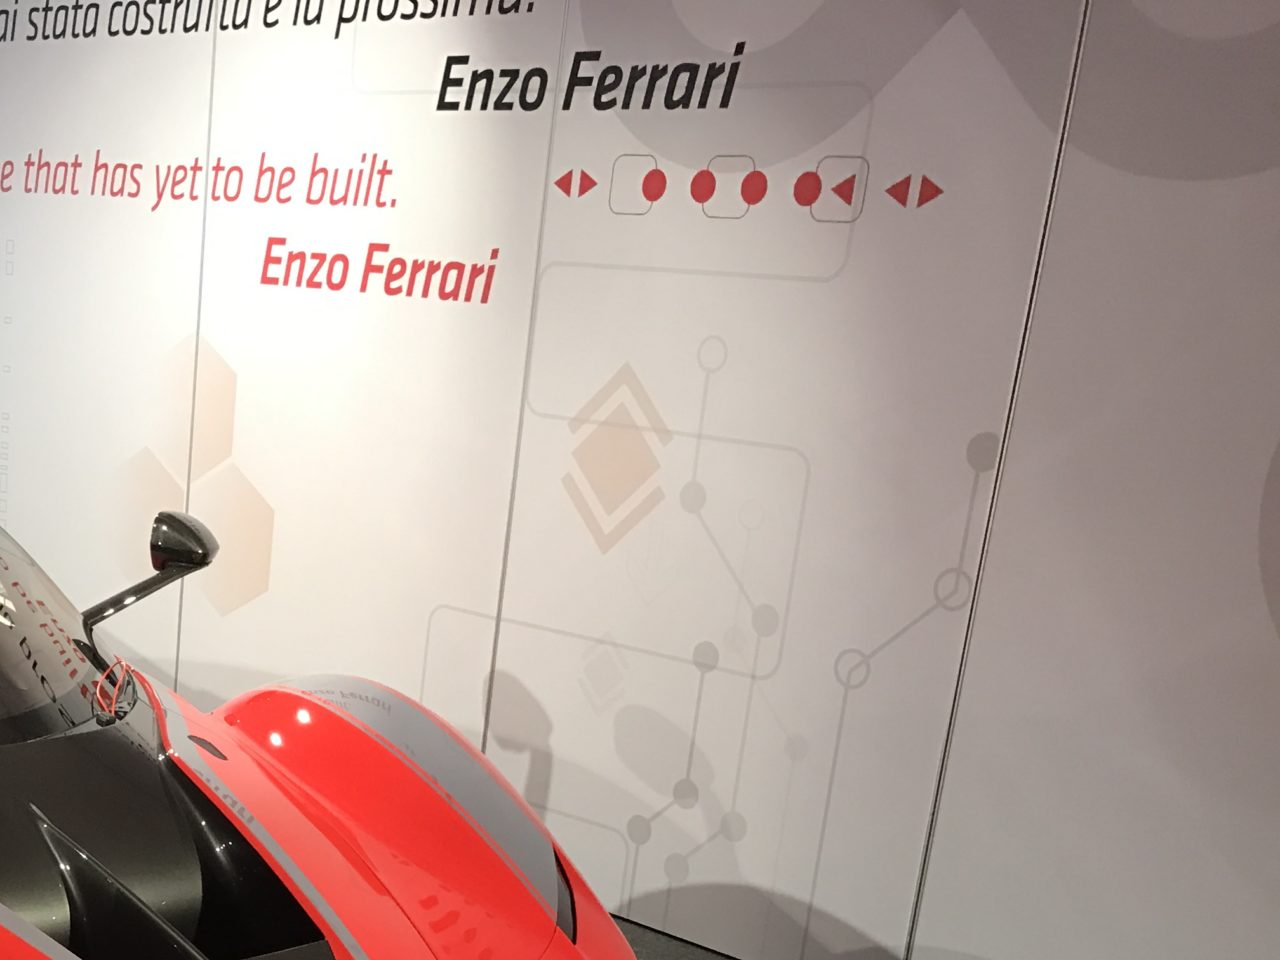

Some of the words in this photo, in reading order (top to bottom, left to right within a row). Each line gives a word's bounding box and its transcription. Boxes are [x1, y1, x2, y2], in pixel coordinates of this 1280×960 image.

[26, 0, 100, 41] stata
[436, 55, 549, 112] Enzo
[562, 41, 746, 112] Ferrari
[24, 148, 82, 195] that
[90, 149, 143, 198] has
[151, 157, 202, 212] yet
[211, 157, 243, 202] to
[254, 152, 296, 204] be
[306, 152, 397, 208] built.
[260, 237, 350, 292] Enzo
[360, 243, 500, 304] Ferrari
